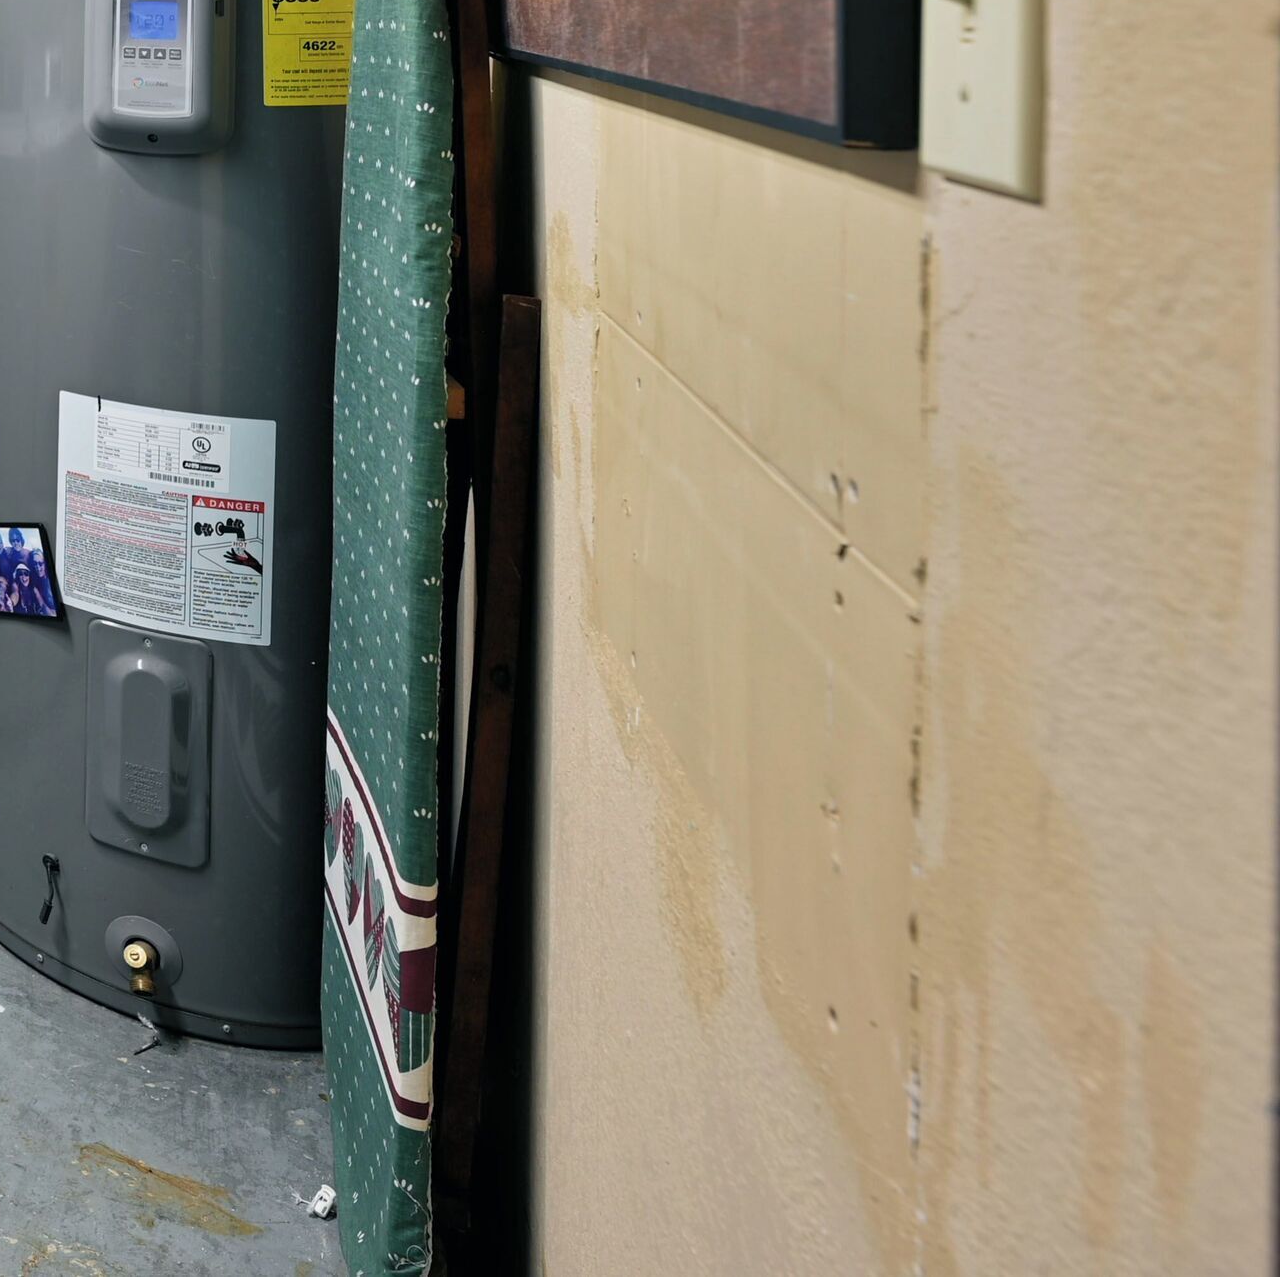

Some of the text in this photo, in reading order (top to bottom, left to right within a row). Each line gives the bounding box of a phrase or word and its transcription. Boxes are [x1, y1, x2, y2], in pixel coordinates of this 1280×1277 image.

[303, 41, 336, 50] 4622
[196, 440, 207, 450] UL
[209, 499, 260, 512] DANGER
